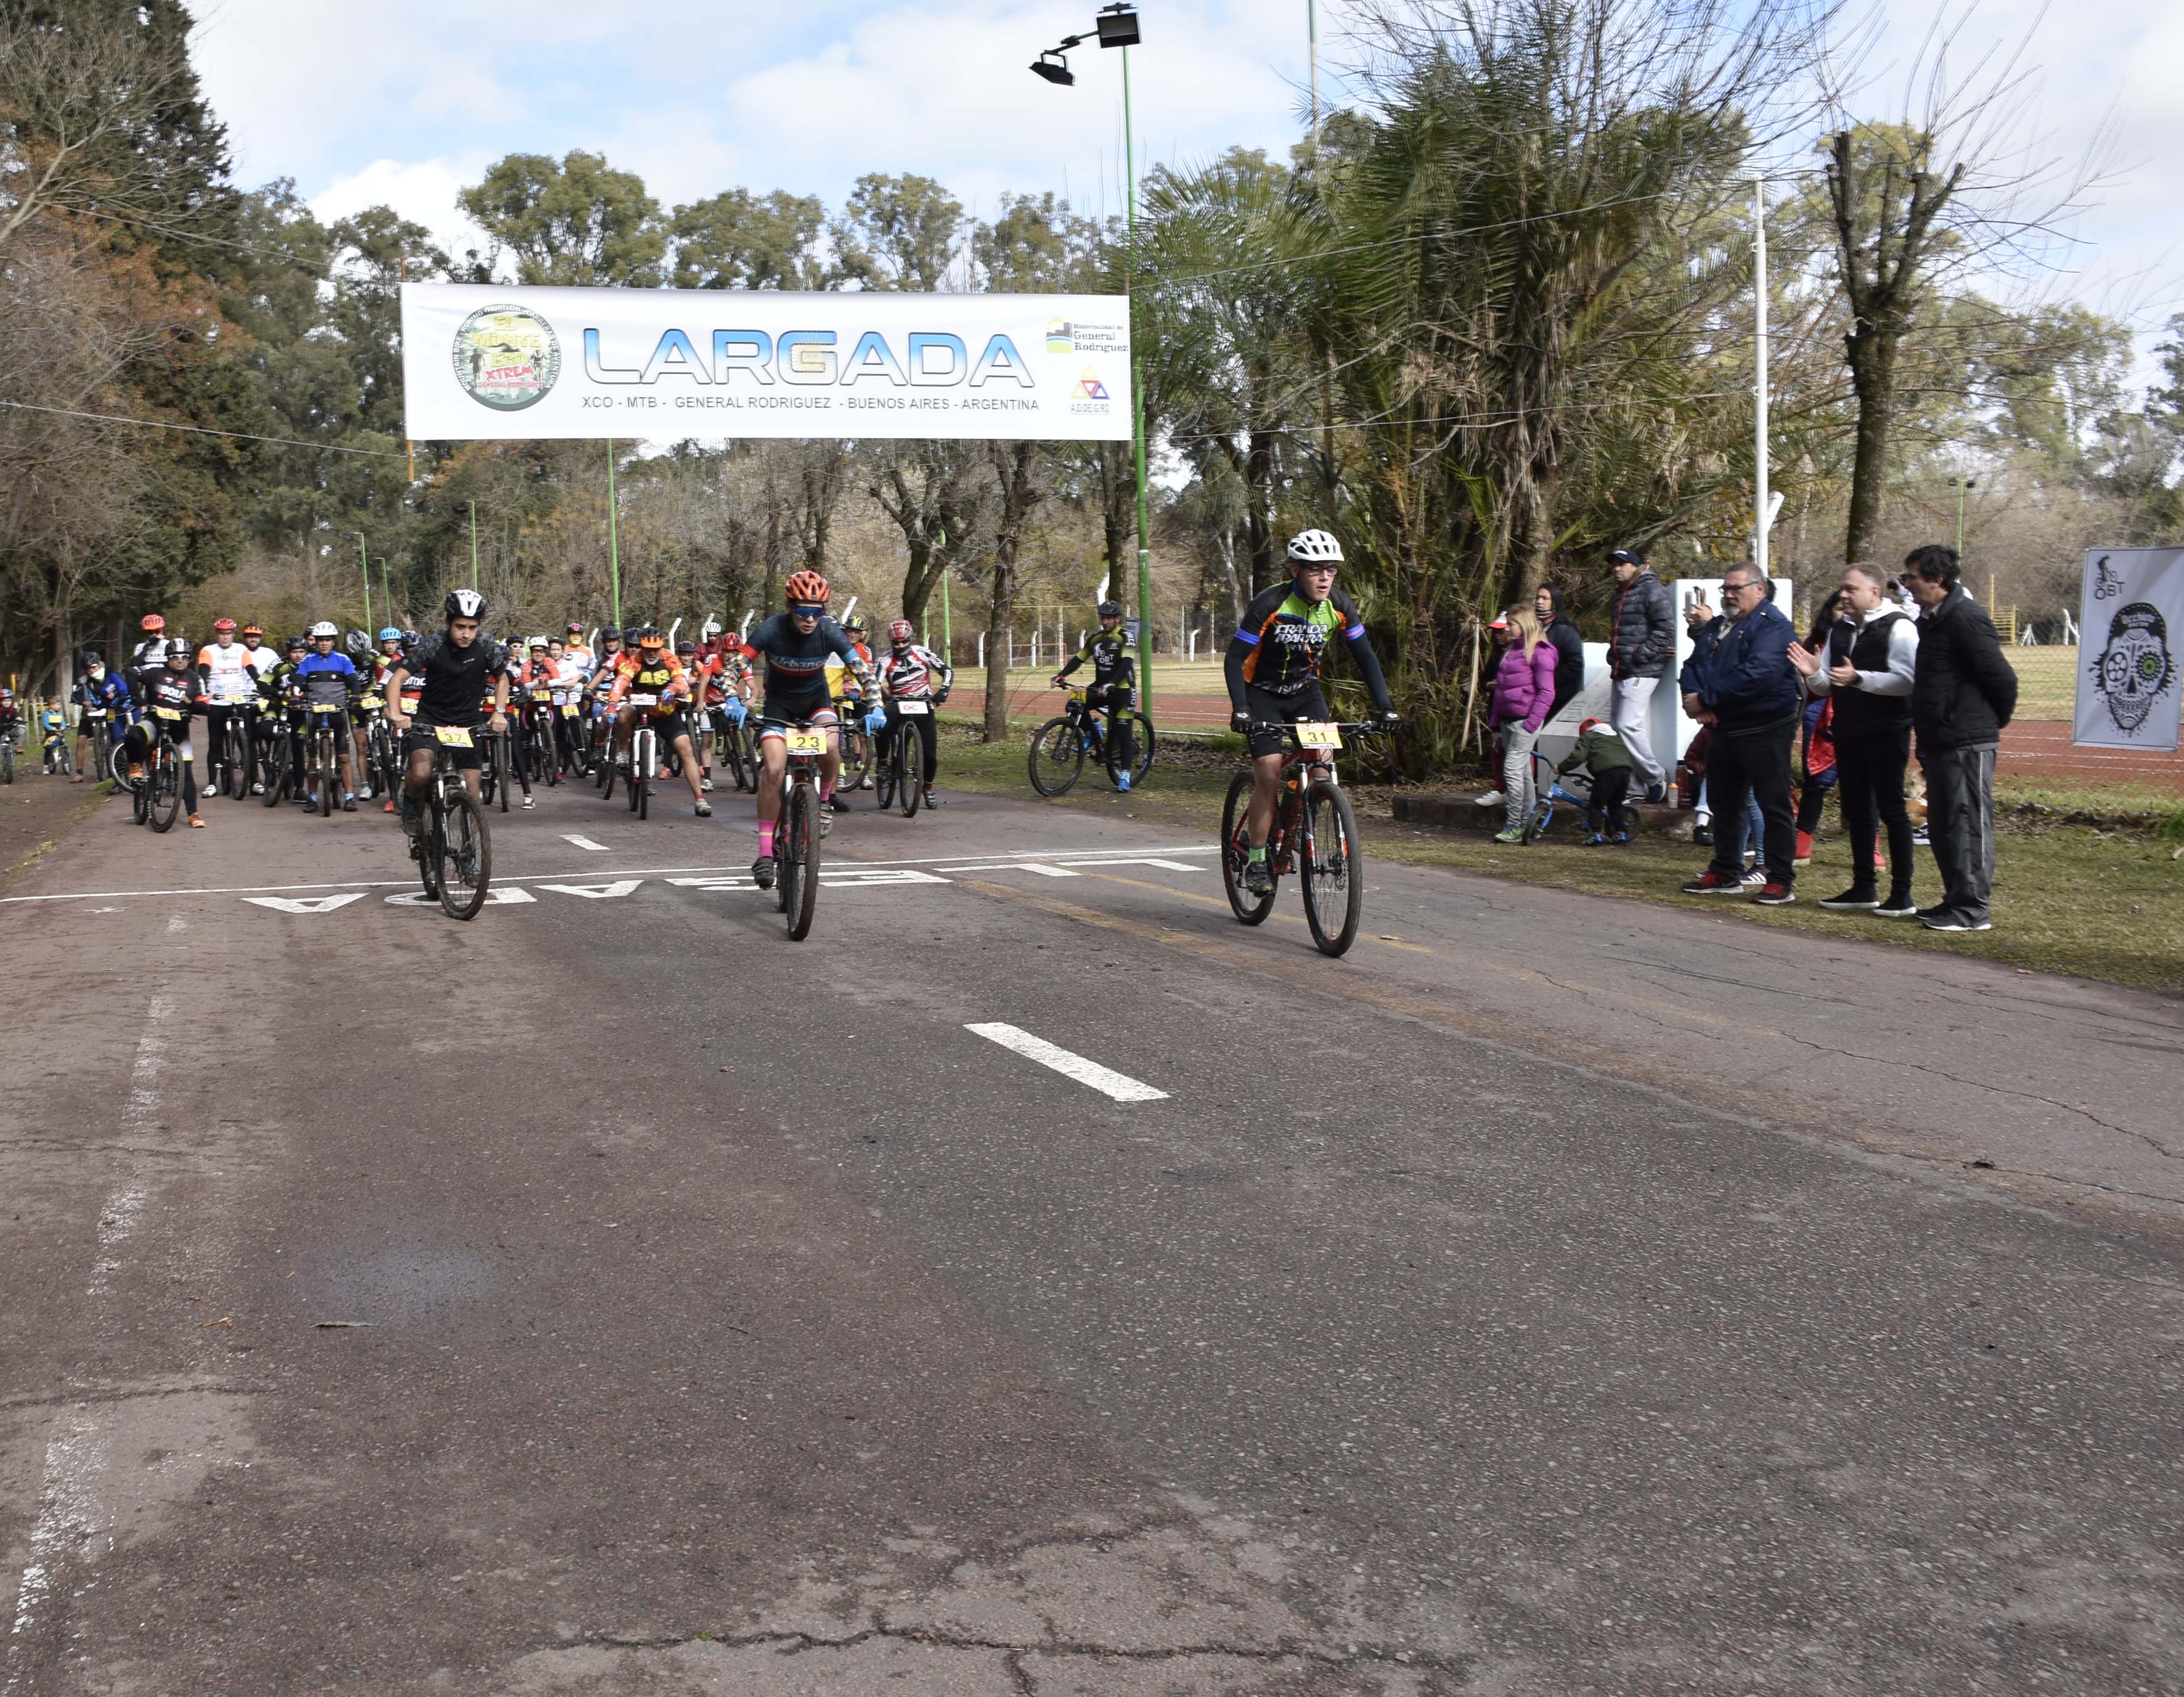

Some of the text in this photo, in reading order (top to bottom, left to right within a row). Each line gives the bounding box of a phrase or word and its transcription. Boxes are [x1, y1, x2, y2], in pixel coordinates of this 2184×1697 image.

[1073, 331, 1115, 341] General
[582, 327, 1035, 388] LARGADA
[485, 364, 535, 381] XTREM
[582, 396, 613, 408] XCO
[627, 396, 658, 408] MTB
[675, 396, 744, 409] GENERAL
[748, 397, 832, 409] RODRIGUEZ
[847, 397, 905, 409] BUENOS
[909, 398, 950, 410] AIRES
[961, 399, 1040, 410] ARGENTINA
[2095, 582, 2125, 600] OBT
[1274, 624, 1329, 635] FRANCO
[444, 733, 461, 742] 37
[796, 736, 820, 748] 23
[1307, 732, 1327, 743] 31
